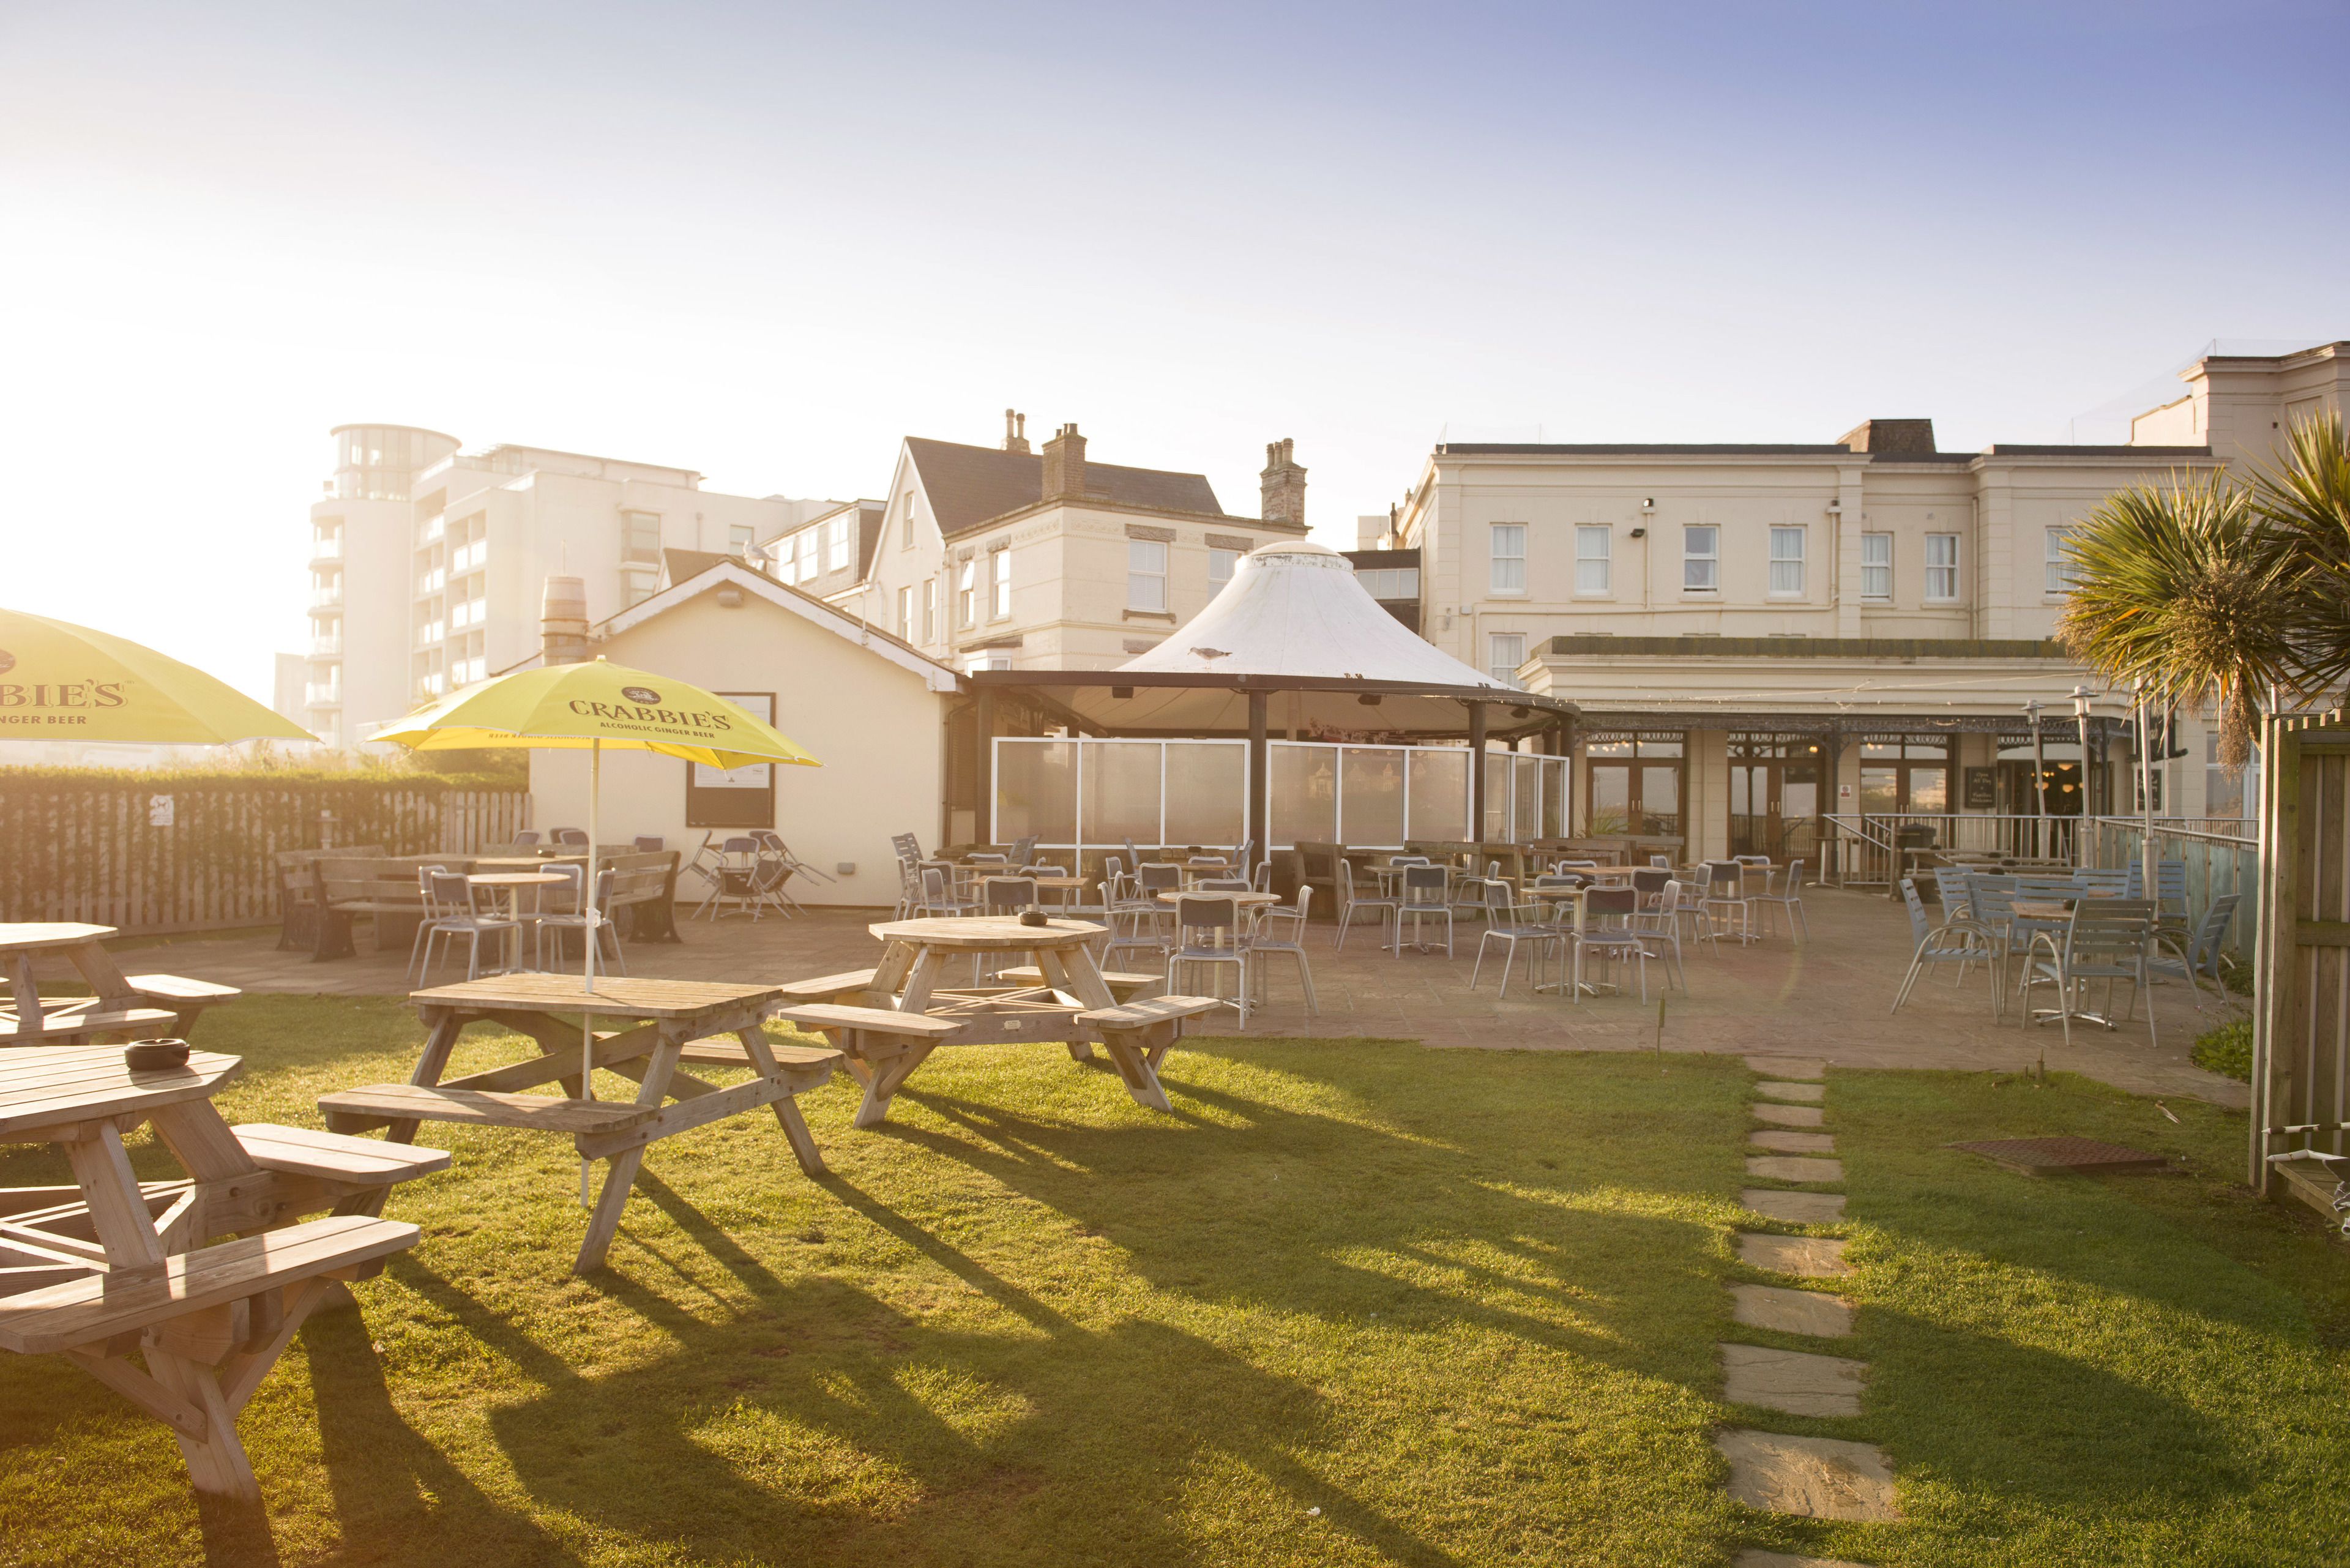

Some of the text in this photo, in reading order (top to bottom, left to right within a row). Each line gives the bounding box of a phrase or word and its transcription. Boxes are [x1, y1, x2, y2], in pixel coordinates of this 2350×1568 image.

[48, 715, 86, 724] BEER
[569, 700, 733, 731] CRABBIE'S
[600, 722, 652, 732] ALCOHOLIC
[655, 727, 690, 736] GINGER
